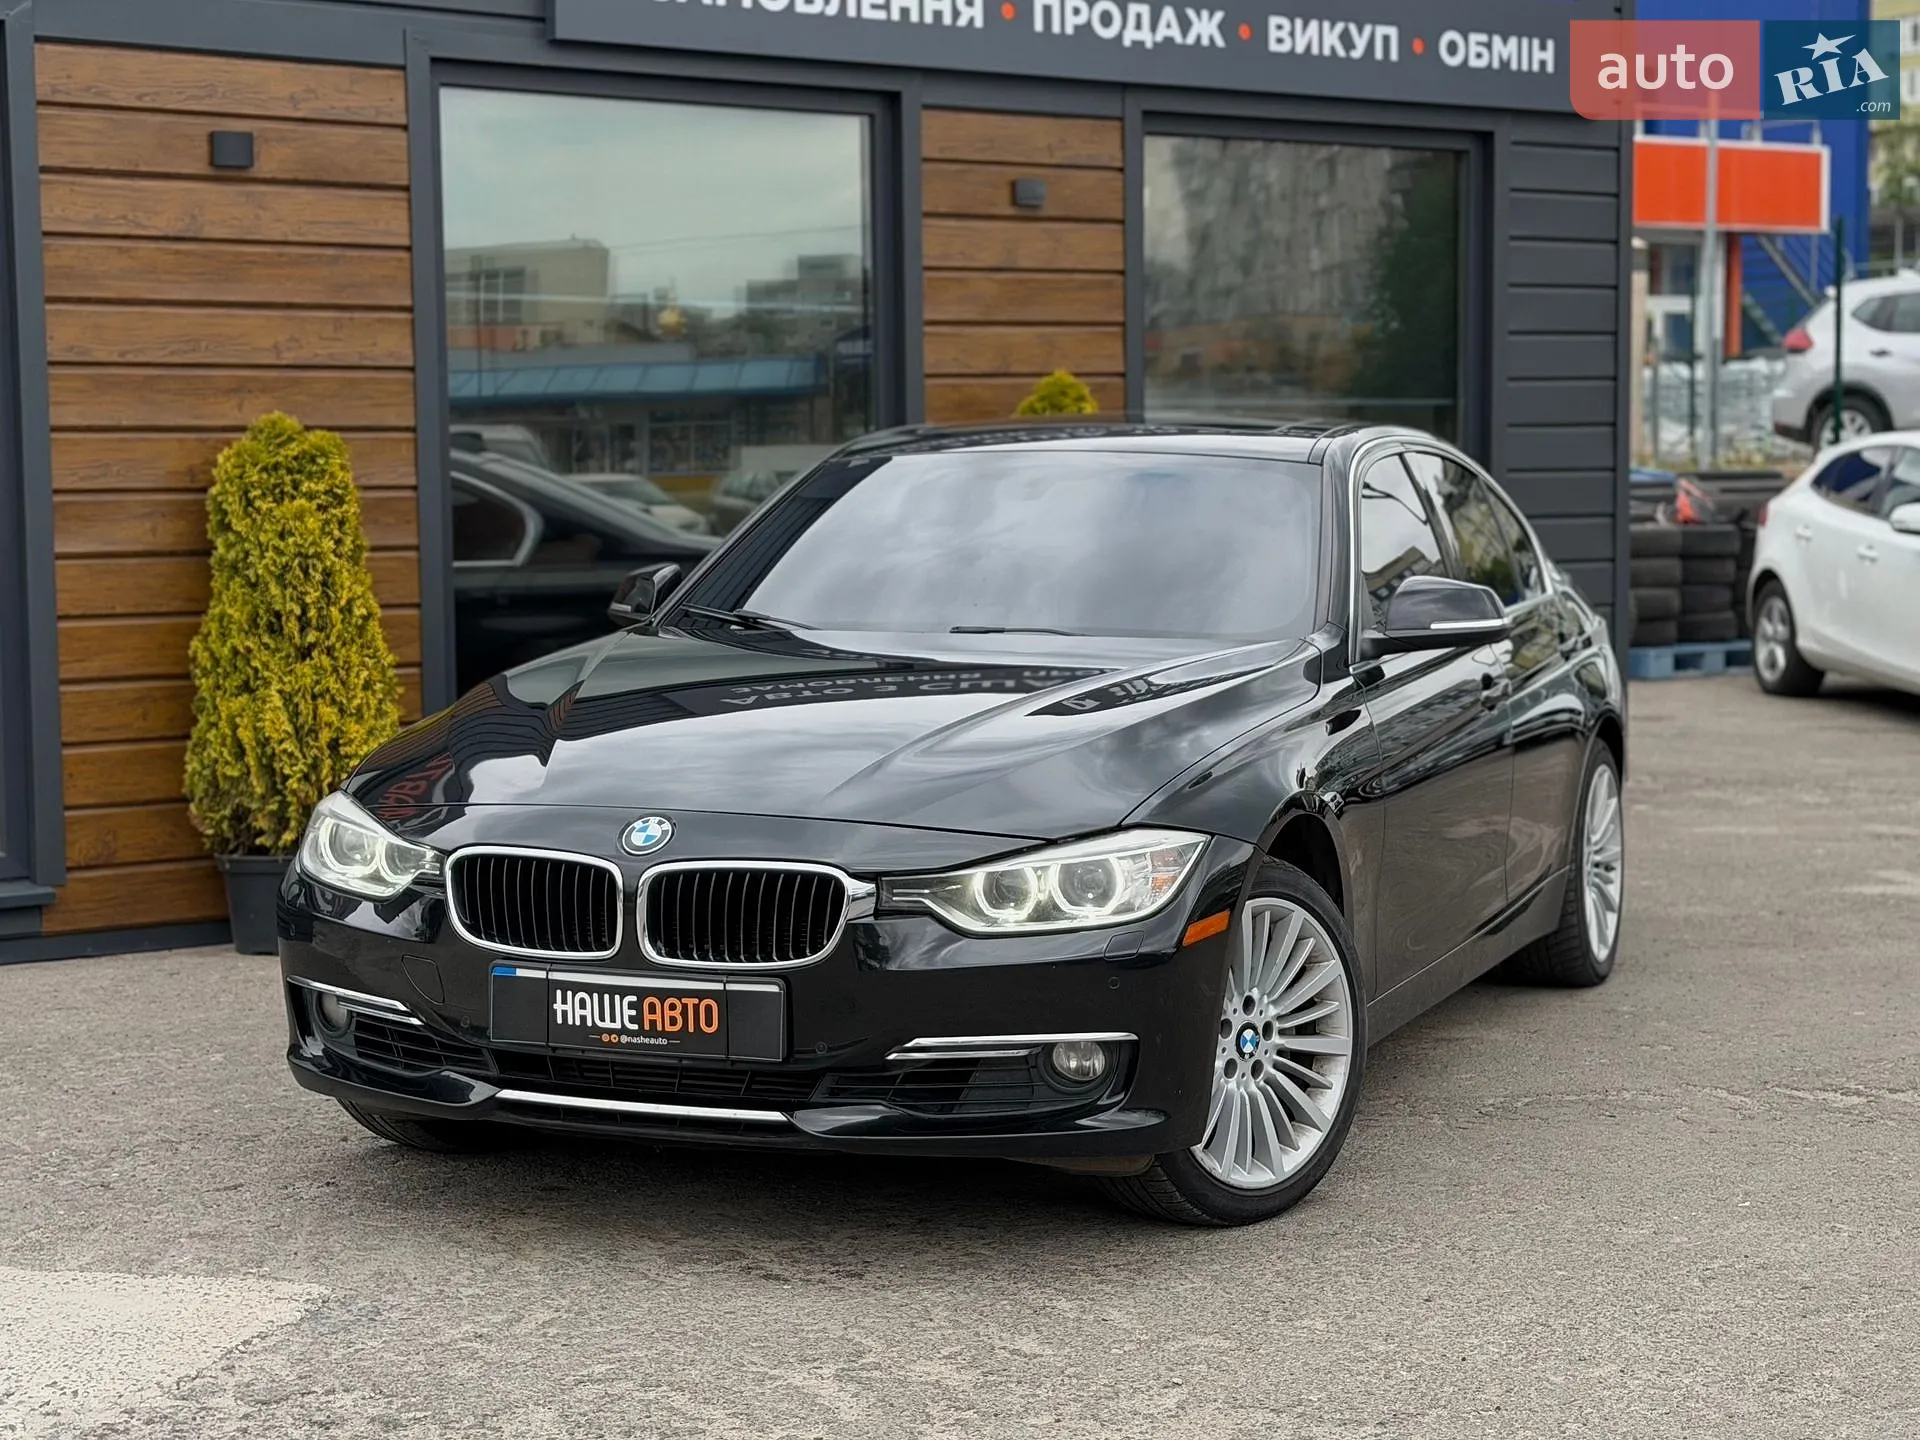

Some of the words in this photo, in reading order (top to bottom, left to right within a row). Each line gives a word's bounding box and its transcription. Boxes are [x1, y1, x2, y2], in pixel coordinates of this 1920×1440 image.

[1033, 0, 1226, 49] ПРОДАЖ
[1267, 15, 1399, 62] ВИКУП
[1438, 30, 1555, 73] ОБМІН
[553, 988, 639, 1030] НАШЕ
[642, 996, 719, 1033] АВТО
[620, 1034, 668, 1045] @nasheauto
